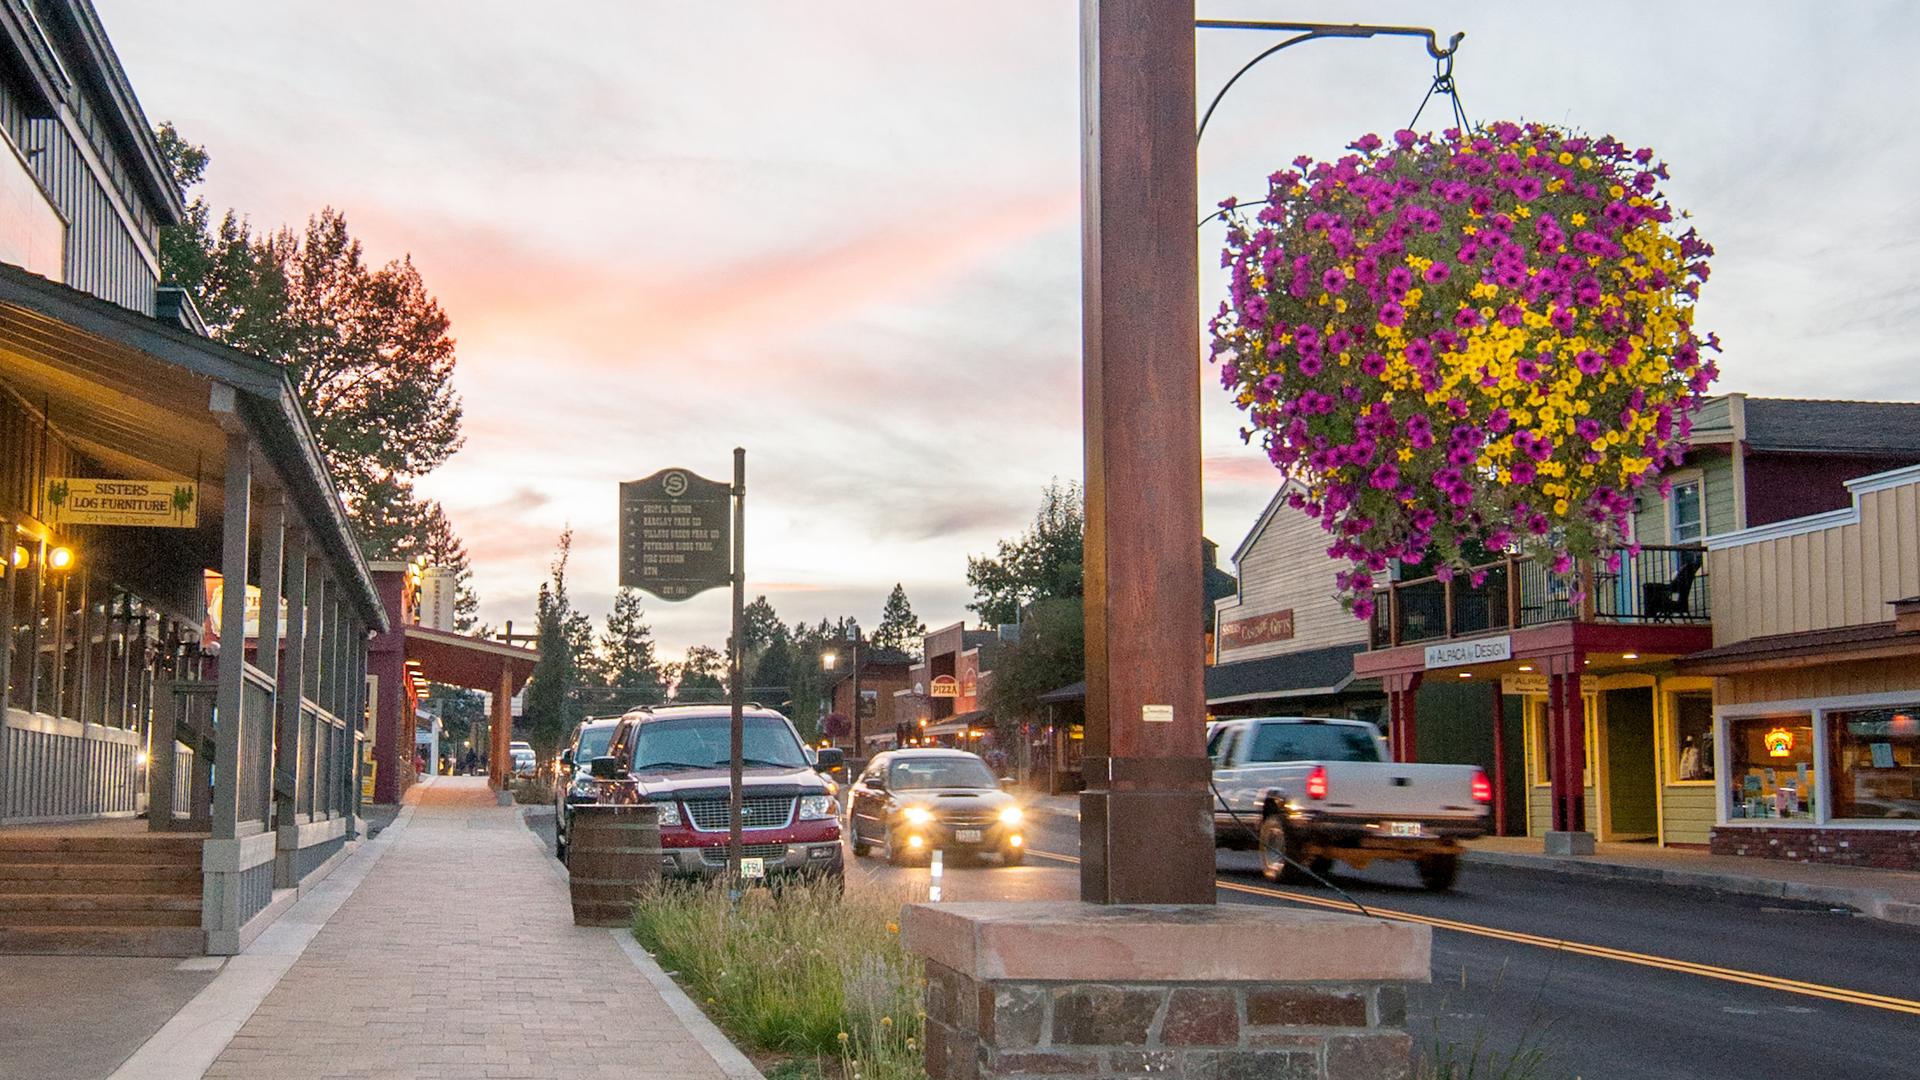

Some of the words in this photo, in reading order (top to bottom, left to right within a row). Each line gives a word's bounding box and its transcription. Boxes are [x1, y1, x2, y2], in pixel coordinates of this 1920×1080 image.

[95, 483, 149, 496] SISTERS
[74, 497, 98, 508] LOG
[101, 498, 168, 511] FURNITURE
[643, 517, 672, 526] BARCLAY
[673, 517, 691, 526] PARK
[691, 529, 709, 538] PARK
[695, 541, 713, 551] TRAIL
[659, 554, 685, 563] STATION
[1437, 648, 1466, 663] ALPACA
[1474, 642, 1506, 659] DESIGN
[933, 685, 957, 694] PIZZA
